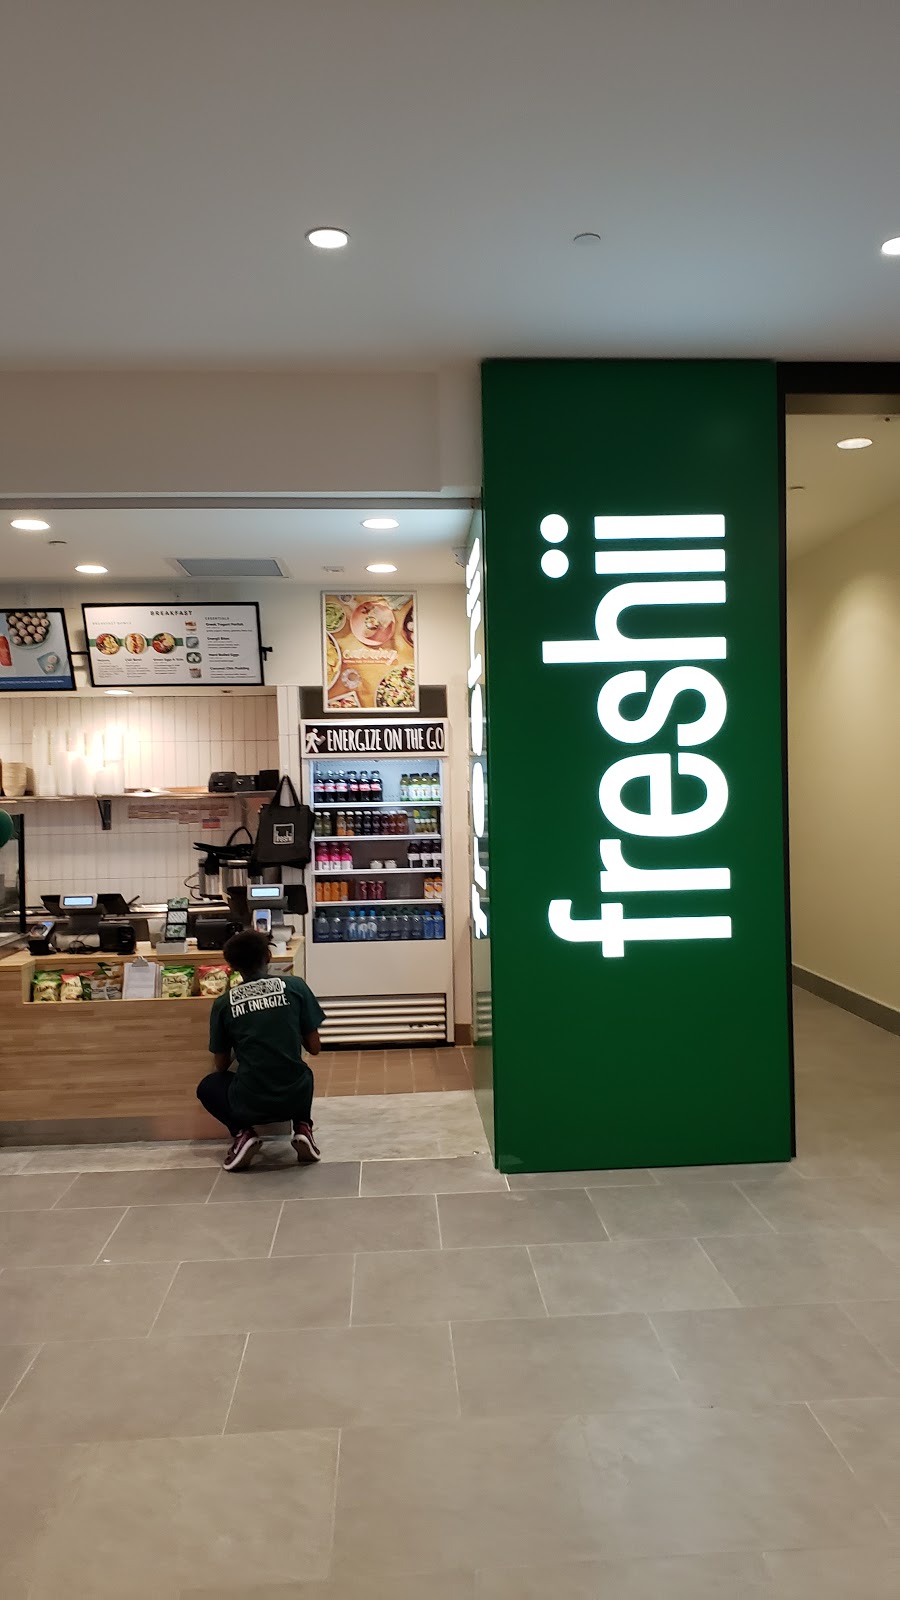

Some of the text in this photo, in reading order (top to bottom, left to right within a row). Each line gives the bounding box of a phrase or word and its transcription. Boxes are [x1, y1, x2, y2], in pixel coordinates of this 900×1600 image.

[327, 726, 444, 752] ENERGIZE ON THE GO
[540, 514, 732, 958] freshii
[231, 994, 291, 1018] EAT. ENERGIZE.
